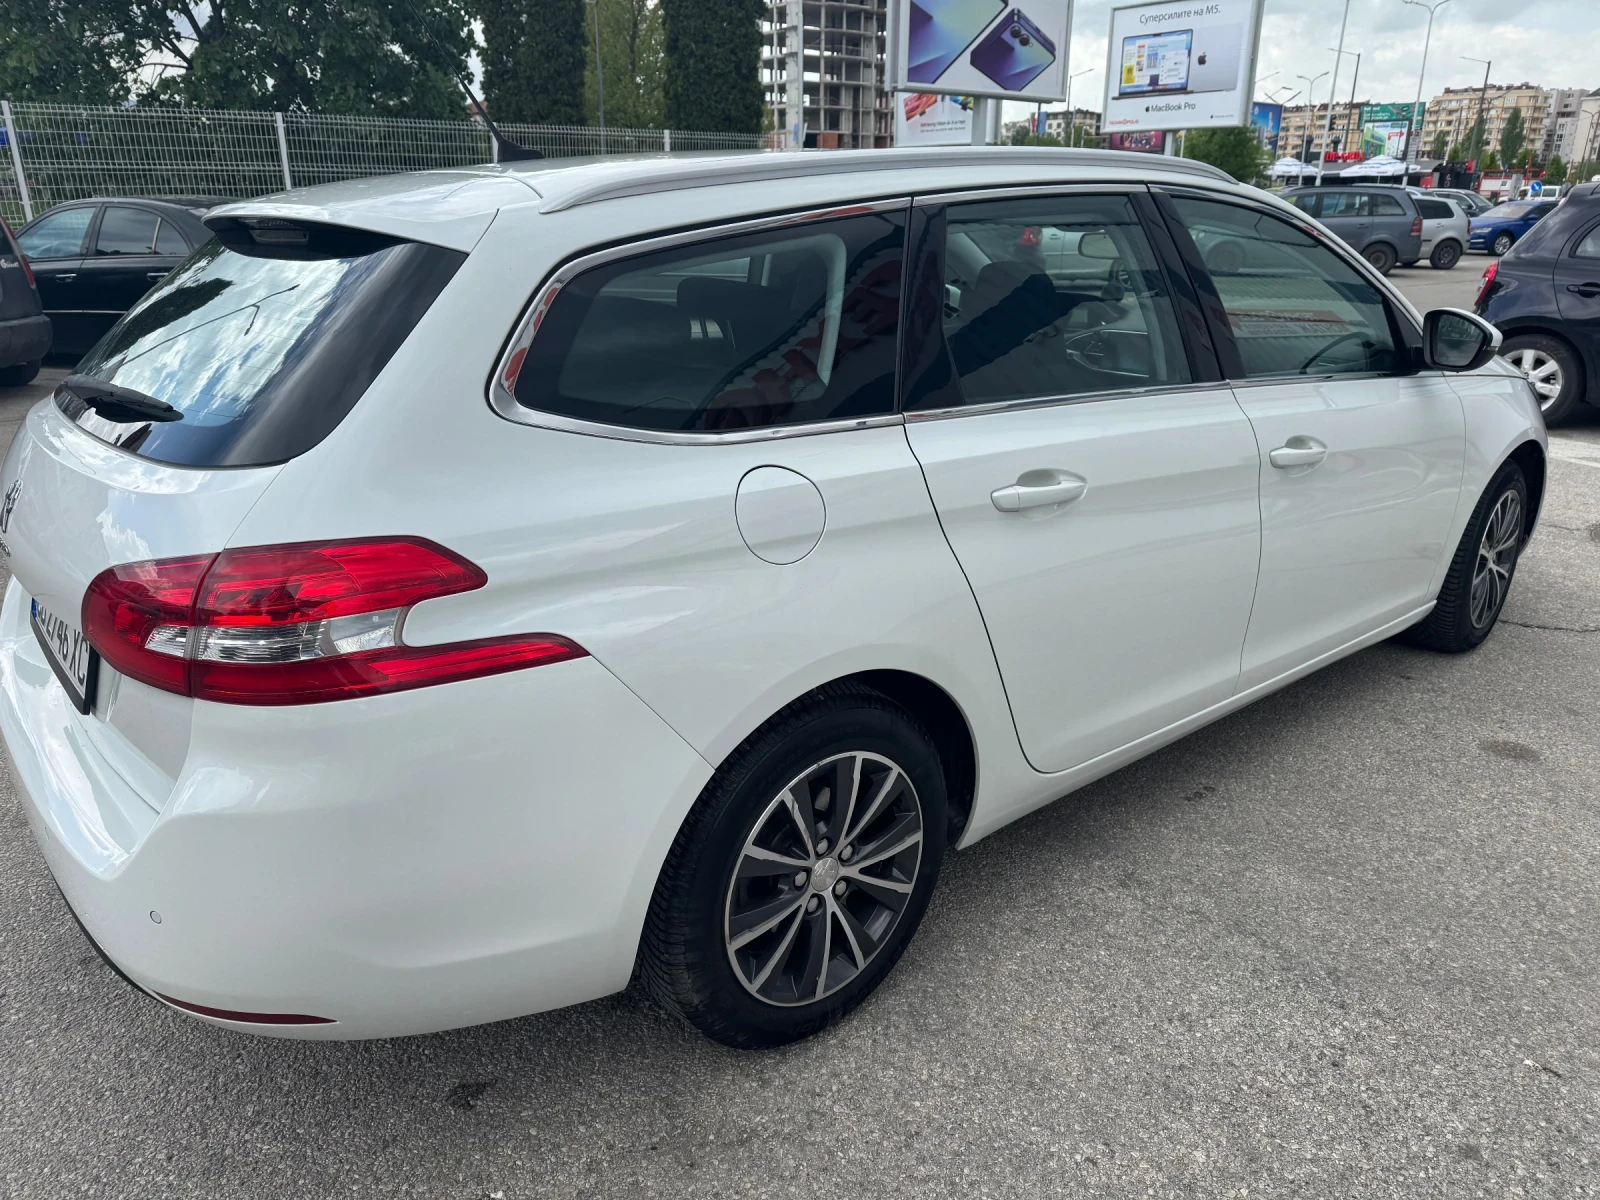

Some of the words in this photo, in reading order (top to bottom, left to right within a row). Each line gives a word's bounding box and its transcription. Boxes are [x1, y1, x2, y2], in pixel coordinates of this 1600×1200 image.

[1139, 10, 1192, 25] Суперсилите
[1193, 8, 1204, 16] на
[1151, 102, 1182, 112] MacBook
[1183, 101, 1196, 110] Pro
